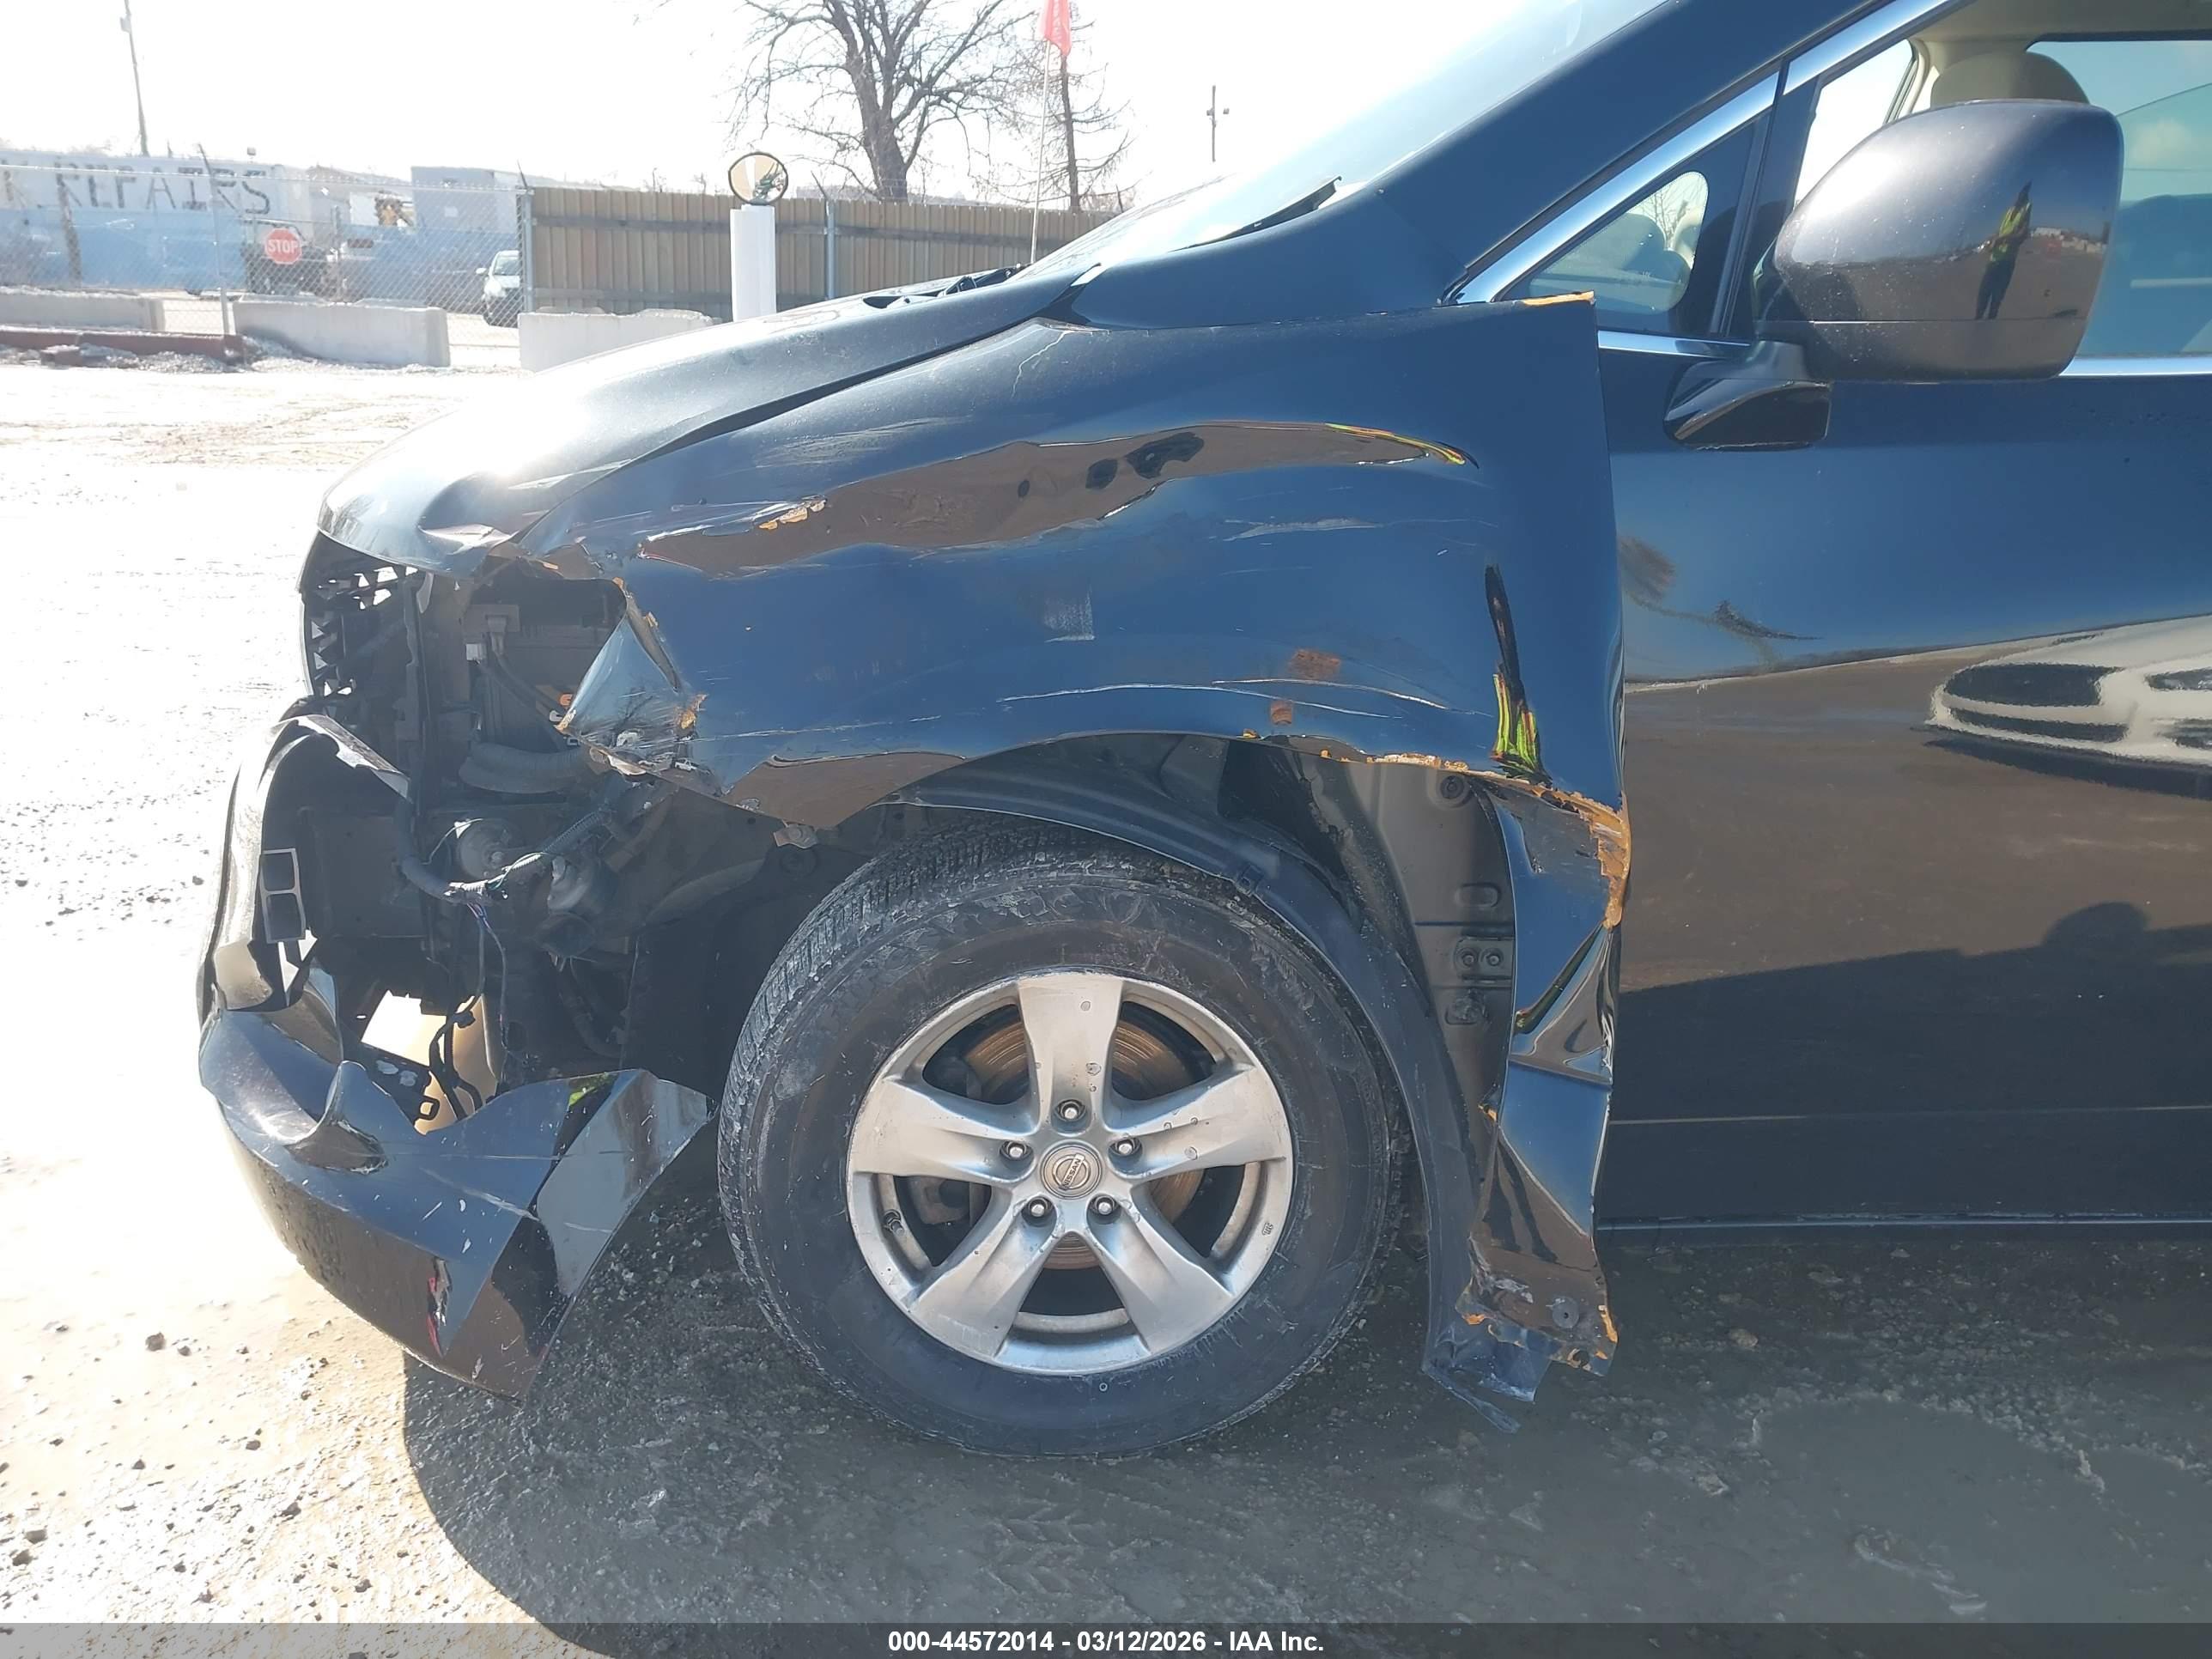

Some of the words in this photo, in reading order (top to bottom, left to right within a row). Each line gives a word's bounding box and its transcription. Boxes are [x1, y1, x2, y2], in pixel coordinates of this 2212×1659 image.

[54, 161, 271, 215] REPAIRS
[268, 240, 298, 254] STOP
[1063, 1158, 1082, 1187] NISSAN
